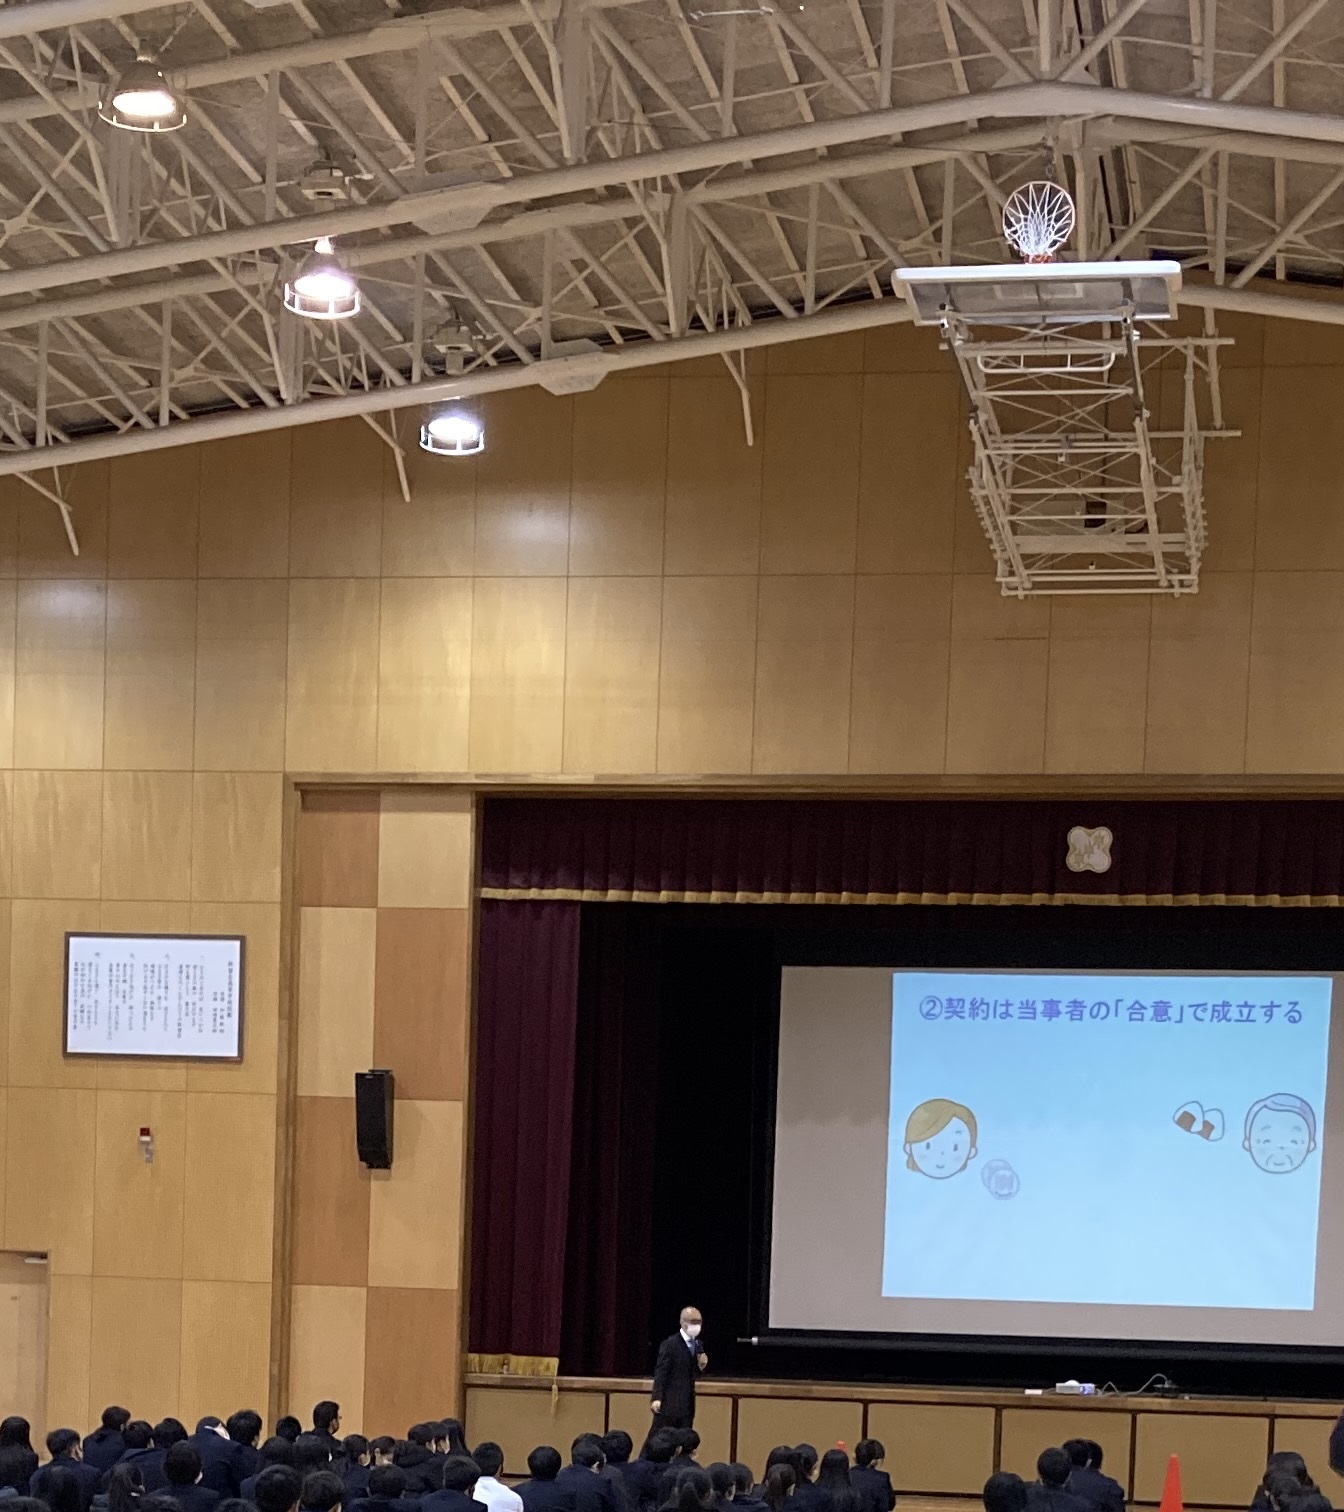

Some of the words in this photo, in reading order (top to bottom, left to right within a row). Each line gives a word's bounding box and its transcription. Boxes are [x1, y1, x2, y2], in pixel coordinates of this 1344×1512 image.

[919, 995, 1303, 1024] ②契約は当事者の「合意」で成立する
